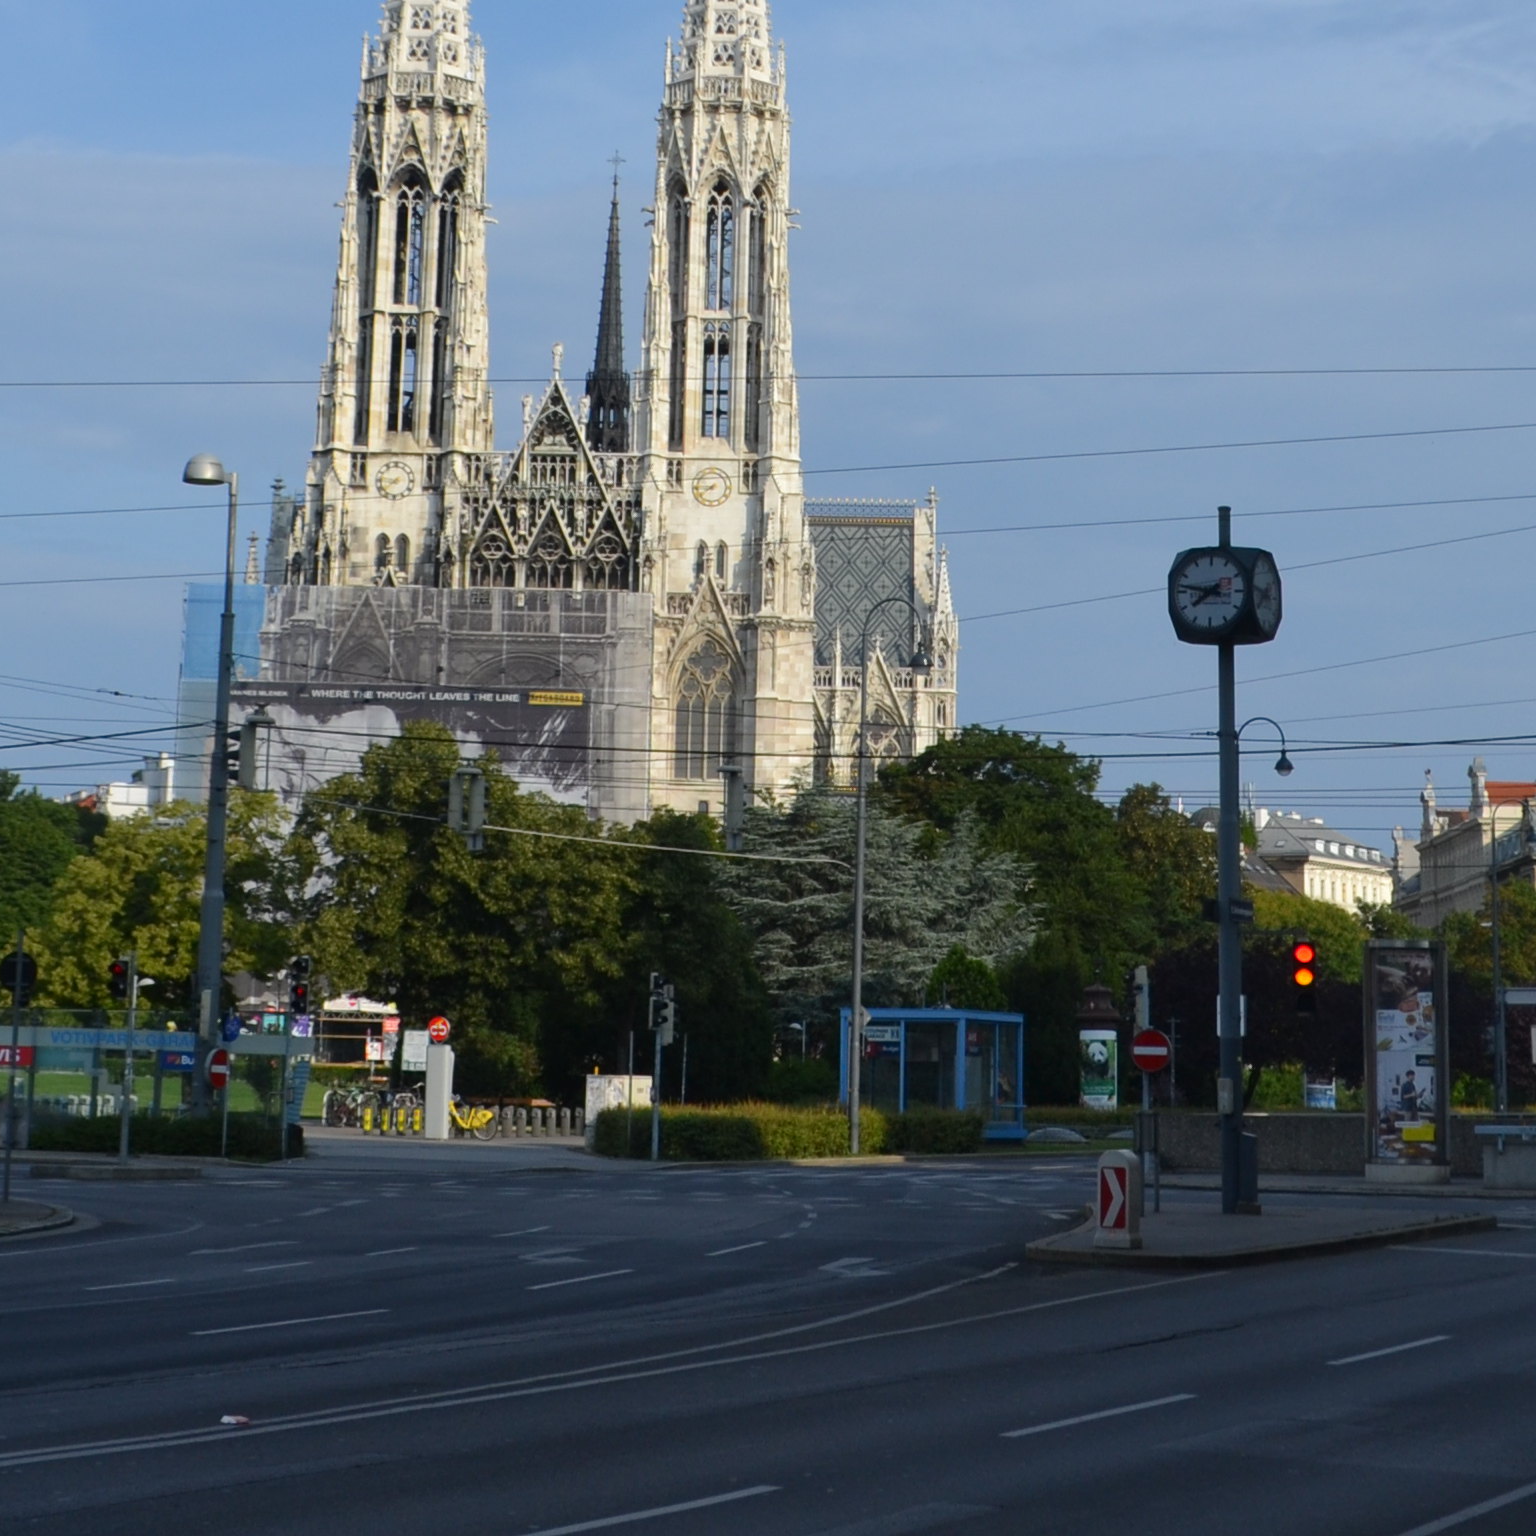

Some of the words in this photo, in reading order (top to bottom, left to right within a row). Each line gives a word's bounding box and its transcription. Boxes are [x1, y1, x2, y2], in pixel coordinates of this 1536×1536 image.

[311, 689, 349, 699] WHERE
[352, 690, 374, 699] THE
[377, 690, 426, 701] THOUGHT
[429, 691, 470, 701] LEAVES
[473, 693, 493, 702] THE
[495, 693, 520, 703] LINE
